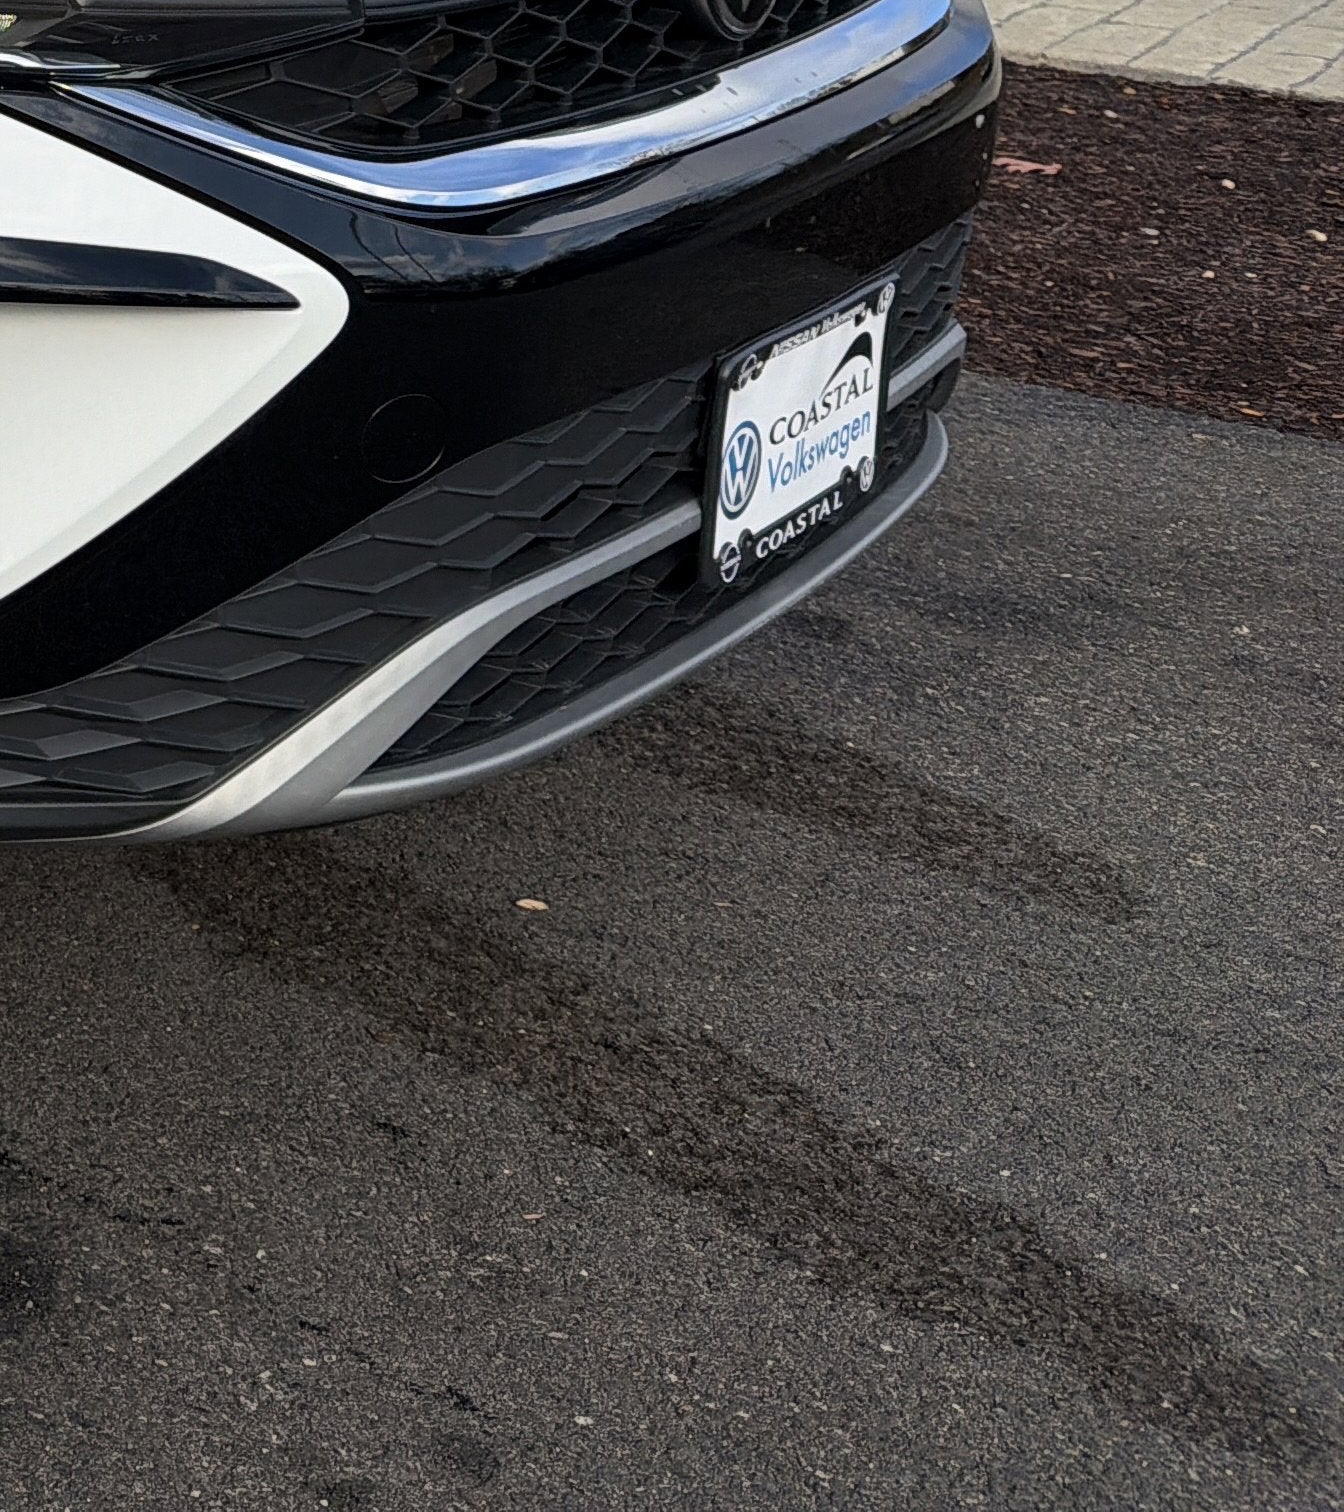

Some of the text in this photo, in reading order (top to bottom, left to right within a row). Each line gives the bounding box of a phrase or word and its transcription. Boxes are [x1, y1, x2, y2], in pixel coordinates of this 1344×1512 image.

[769, 367, 874, 445] COASTAL
[768, 410, 871, 493] Volkswagen
[755, 491, 844, 558] COASTAL
